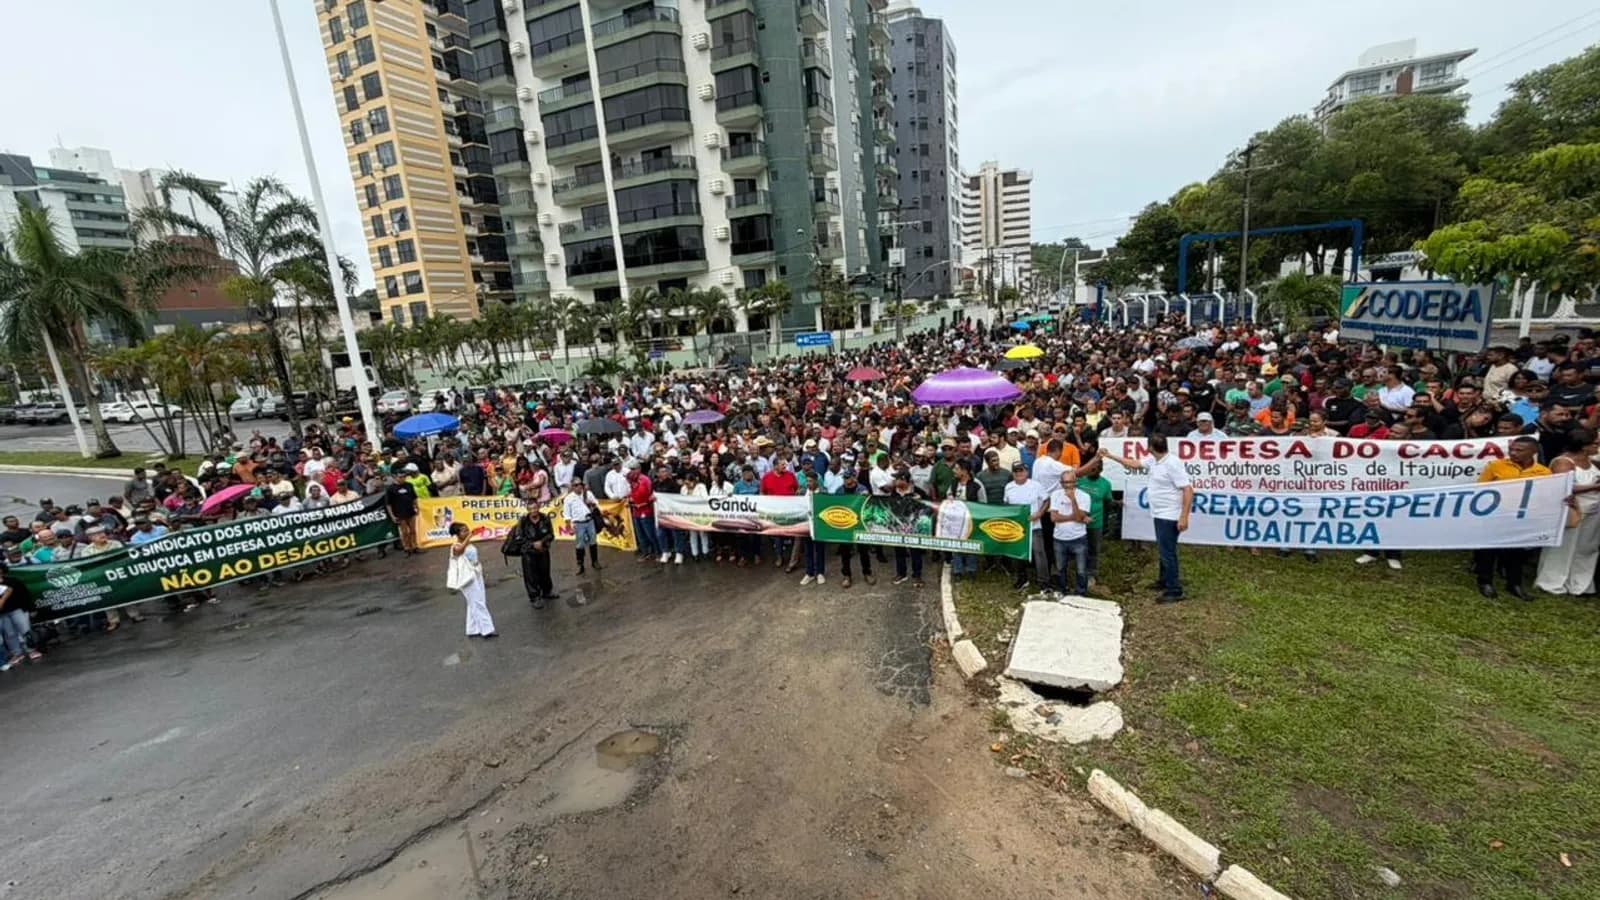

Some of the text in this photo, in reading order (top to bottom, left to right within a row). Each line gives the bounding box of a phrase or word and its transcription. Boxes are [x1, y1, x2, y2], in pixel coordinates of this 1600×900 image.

[1368, 289, 1482, 323] CODEBA
[1178, 440, 1312, 460] DEFESA
[1332, 441, 1380, 460] DO
[1397, 441, 1507, 460] CACA
[1208, 461, 1281, 475] Produtores
[1294, 460, 1347, 477] Rurais
[1365, 461, 1387, 475] de
[1231, 476, 1252, 489] dos
[1259, 476, 1345, 492] Agricultores
[1351, 477, 1409, 491] Familiar
[462, 499, 528, 509] PREFEITUR
[708, 497, 757, 513] Gandu
[1318, 489, 1501, 518] RESPEITO
[472, 512, 490, 521] EM
[128, 501, 365, 559] O SINDICATO DOS PRODUTORES RURAIS
[1224, 520, 1380, 544] UBAITABA
[104, 508, 387, 582] DE URUÇUCA EM DEFESA DOS CACAUICULTORES
[160, 533, 357, 592] NÃO AO DESÁGIO!
